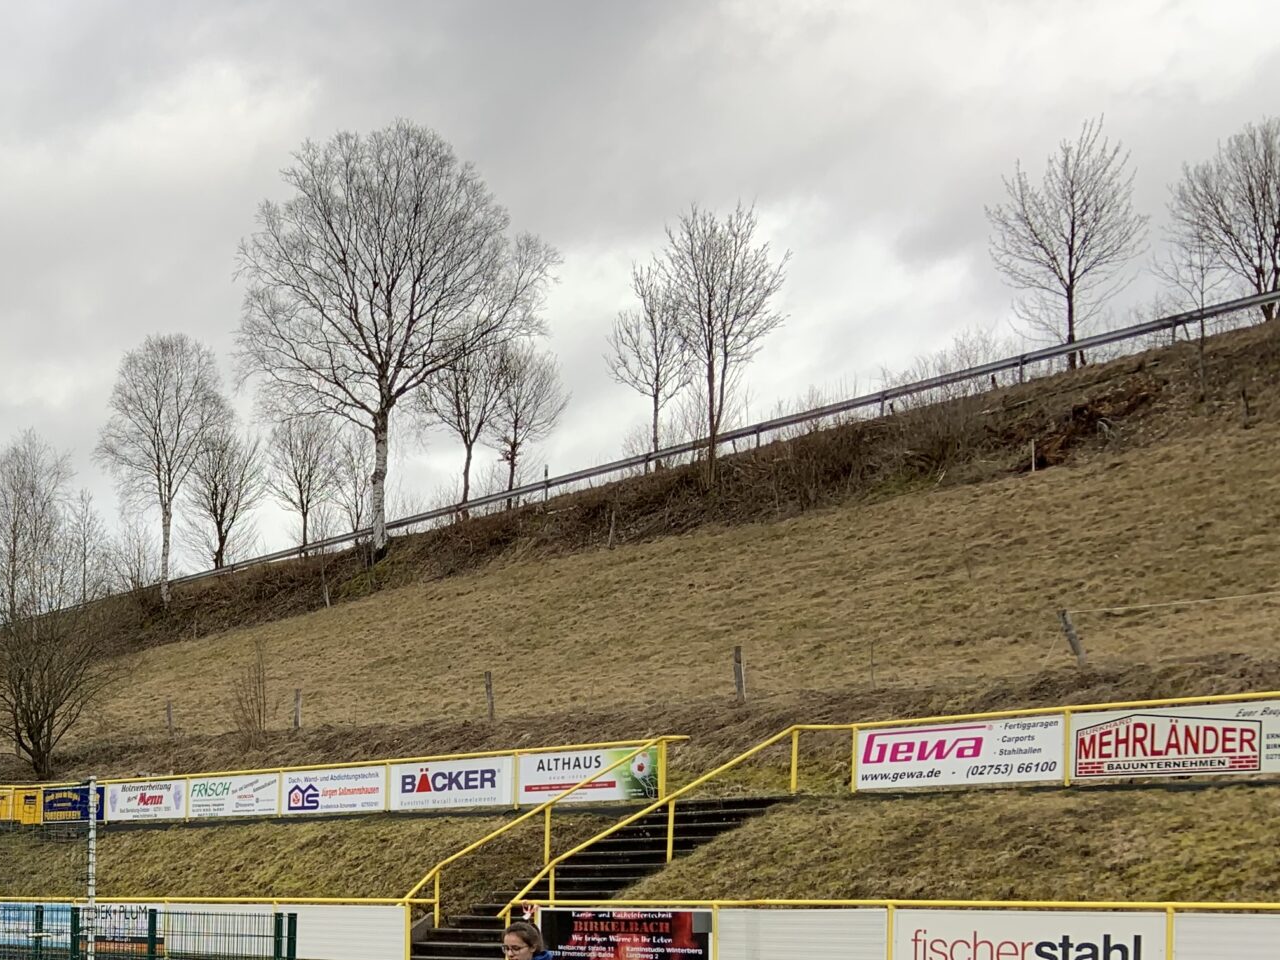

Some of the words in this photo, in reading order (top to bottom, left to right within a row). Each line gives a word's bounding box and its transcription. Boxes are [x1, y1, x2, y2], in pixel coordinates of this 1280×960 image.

[1004, 720, 1058, 730] Fertiggaragen
[1079, 718, 1132, 736] BURKHARD
[1002, 734, 1035, 744] Carports
[1078, 719, 1256, 759] MEHRLÄNDER
[999, 747, 1041, 756] Stahlhallen
[537, 755, 602, 772] ALTHAUS
[1107, 759, 1226, 771] BAUUNTERNEHMEN
[330, 772, 379, 781] Abdichtungstechnik
[861, 768, 941, 782] www.gewa.de
[966, 764, 1013, 778] (02753)
[1017, 761, 1056, 773] 66100
[401, 768, 497, 793] BÄCKER
[121, 783, 172, 793] Holzverarbeitung
[191, 781, 232, 797] FRISCH
[574, 921, 670, 933] BIRKELBACH
[666, 947, 702, 955] Winterberg
